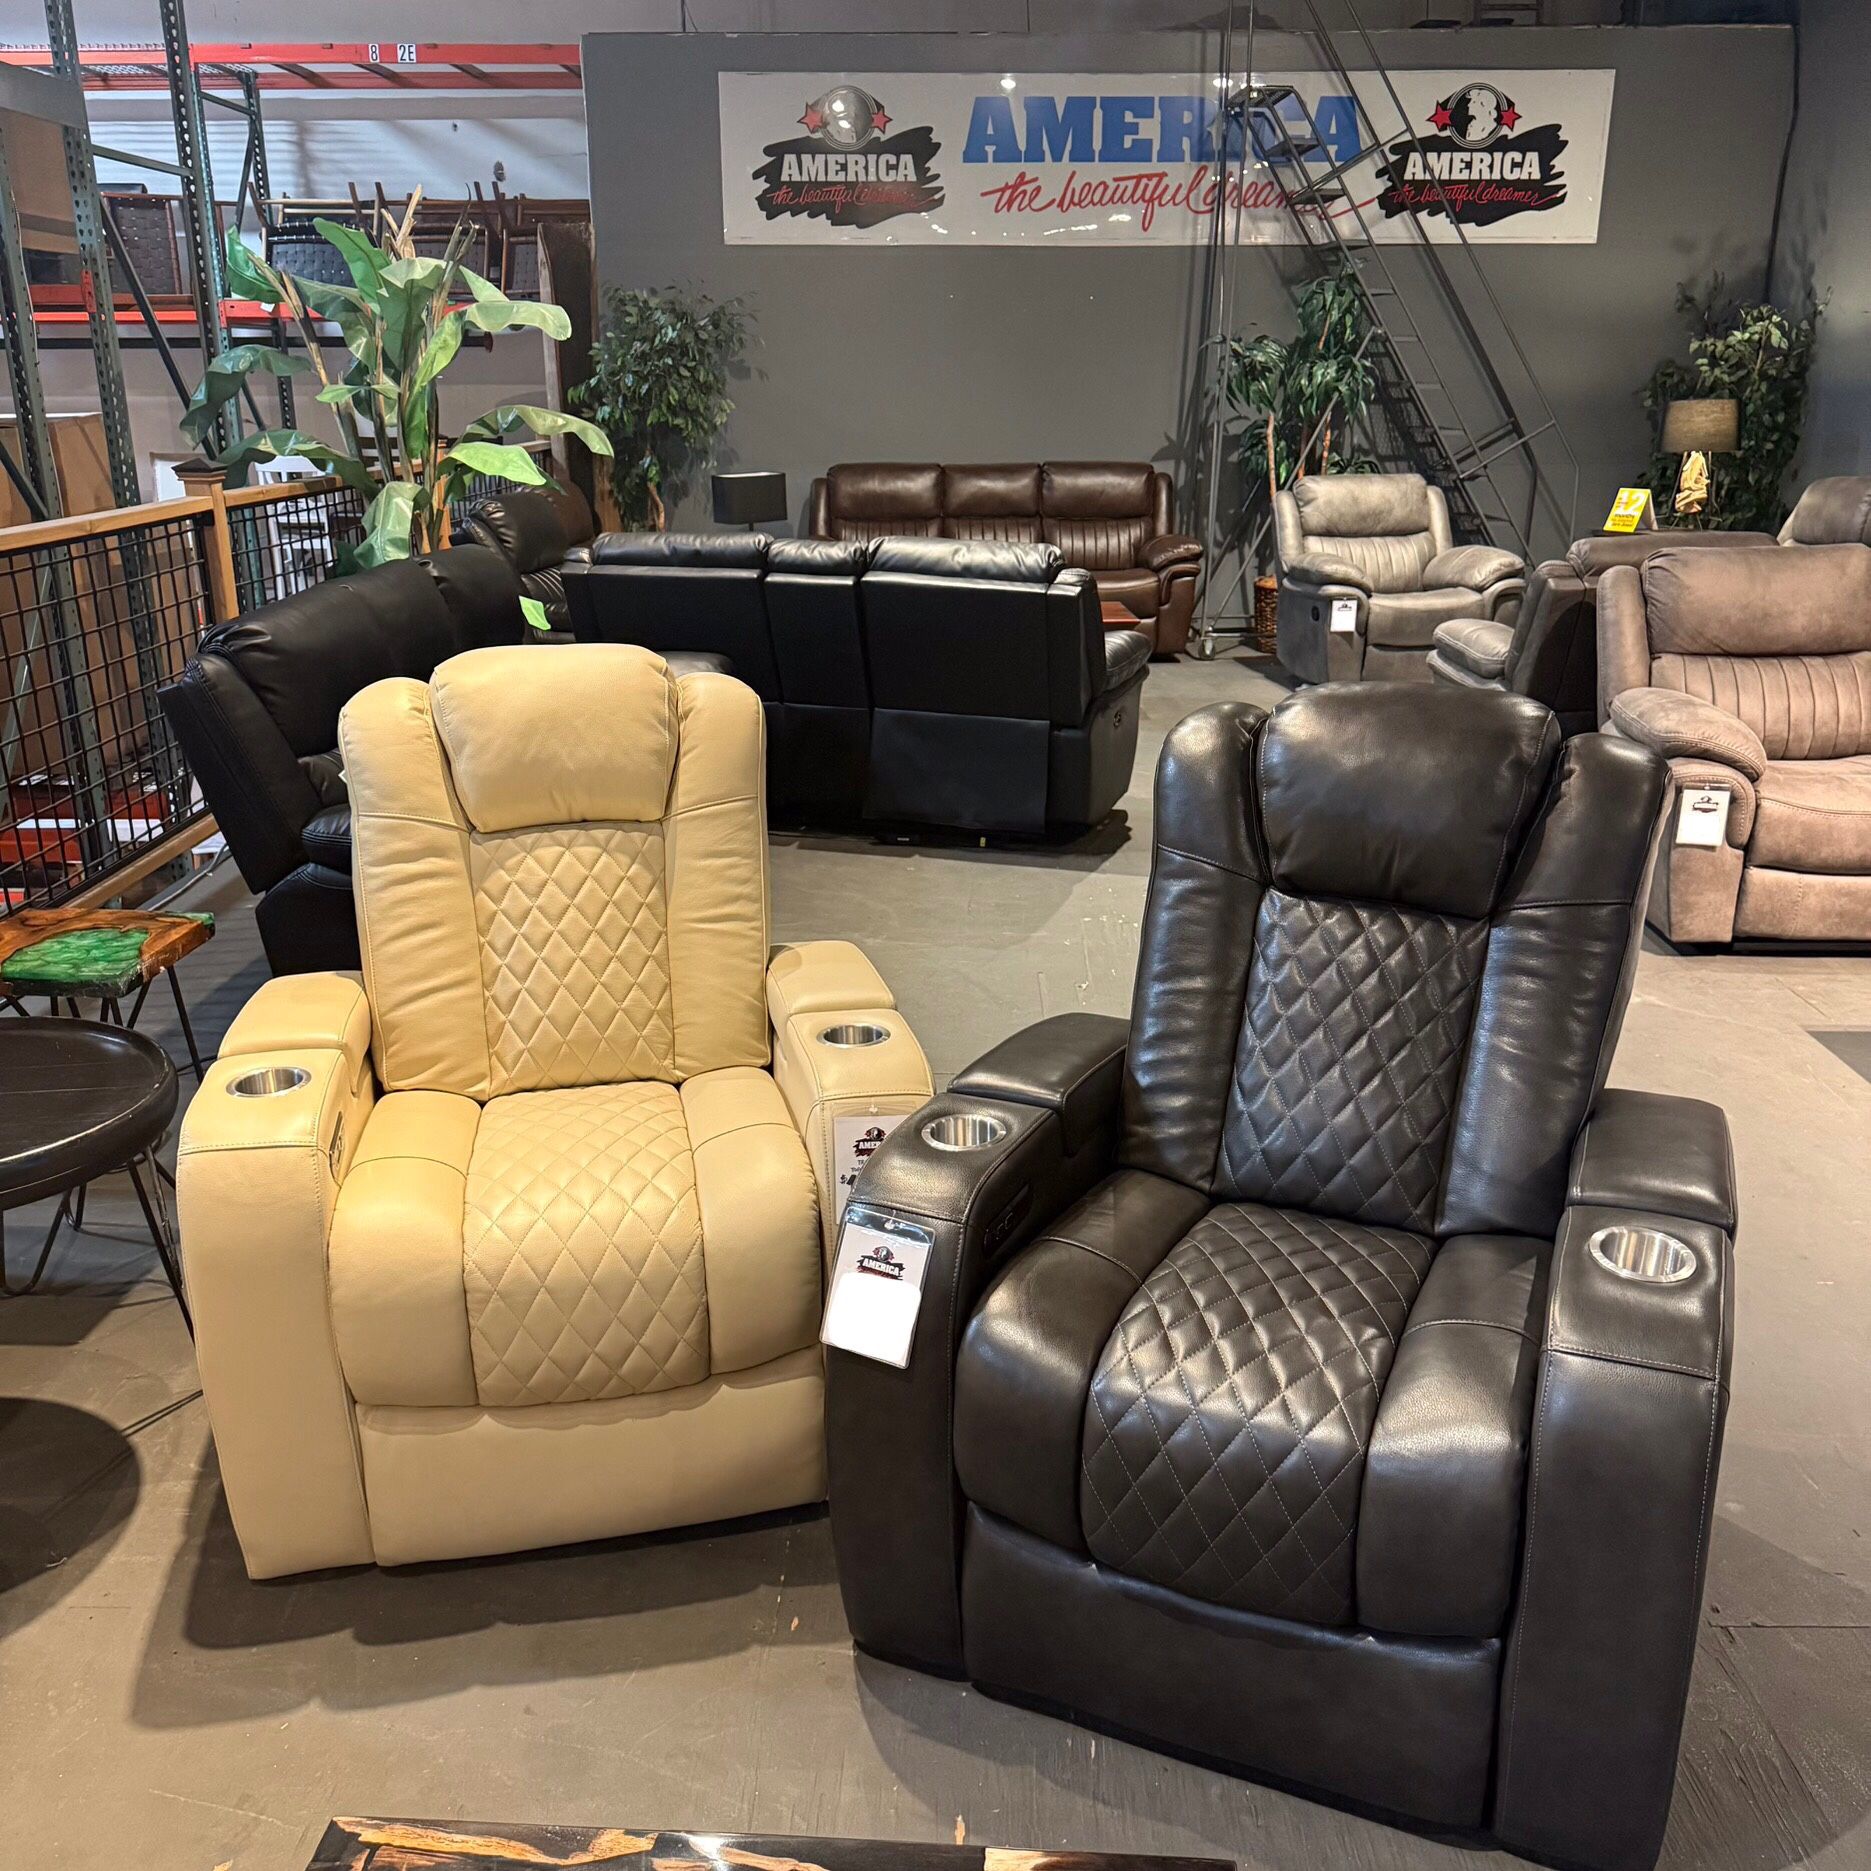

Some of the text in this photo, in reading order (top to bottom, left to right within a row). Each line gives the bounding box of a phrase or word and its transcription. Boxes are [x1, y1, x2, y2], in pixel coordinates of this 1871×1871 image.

[370, 44, 415, 61] 8 2E
[780, 153, 918, 183] AMERICA
[1403, 151, 1542, 181] AMERICA
[767, 184, 801, 206] the
[799, 182, 868, 214] beautiful
[980, 171, 1057, 213] the
[1057, 165, 1216, 233] beautiful
[1208, 170, 1377, 221] drea
[1420, 180, 1488, 213] beautiful
[1483, 184, 1563, 207] dreamer
[862, 1257, 900, 1277] AMERICA
